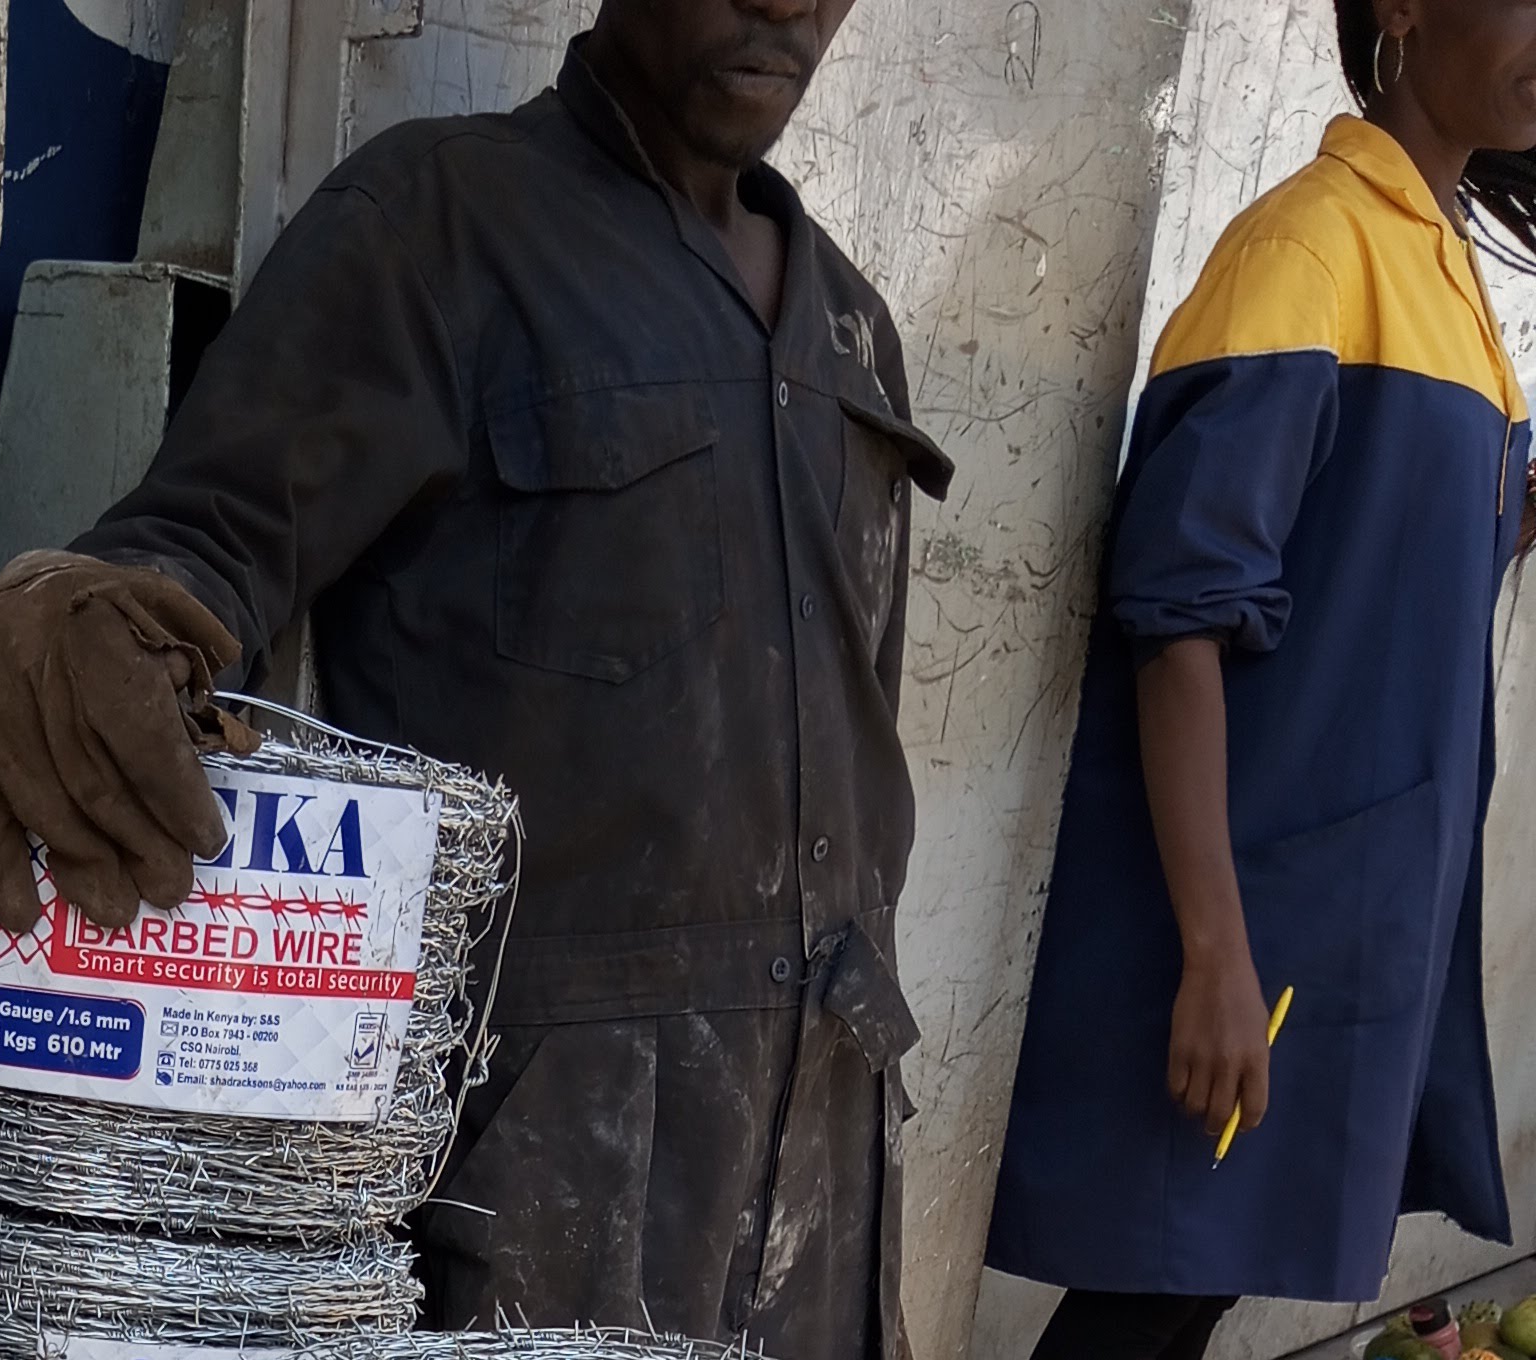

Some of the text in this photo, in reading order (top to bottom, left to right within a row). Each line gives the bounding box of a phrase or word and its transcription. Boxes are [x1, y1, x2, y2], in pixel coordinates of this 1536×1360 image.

[78, 912, 364, 966] BARBED WIRE
[77, 949, 402, 999] Smart security is total security
[0, 1000, 54, 1026] Gauge
[57, 1007, 91, 1029] /1.6
[95, 1014, 132, 1031] mm
[163, 1007, 191, 1019] Made
[207, 1011, 239, 1026] Kenya
[241, 1014, 257, 1027] by:
[260, 1015, 280, 1026] S&S
[3, 1029, 37, 1054] Kgs
[47, 1034, 85, 1058] 610
[89, 1040, 123, 1062] Mtr
[180, 1041, 202, 1053] CSQ
[182, 1026, 198, 1037] P.O
[201, 1027, 220, 1039] Box
[223, 1029, 244, 1040] 7943
[252, 1031, 279, 1043] 00200
[177, 1073, 207, 1086] Email:
